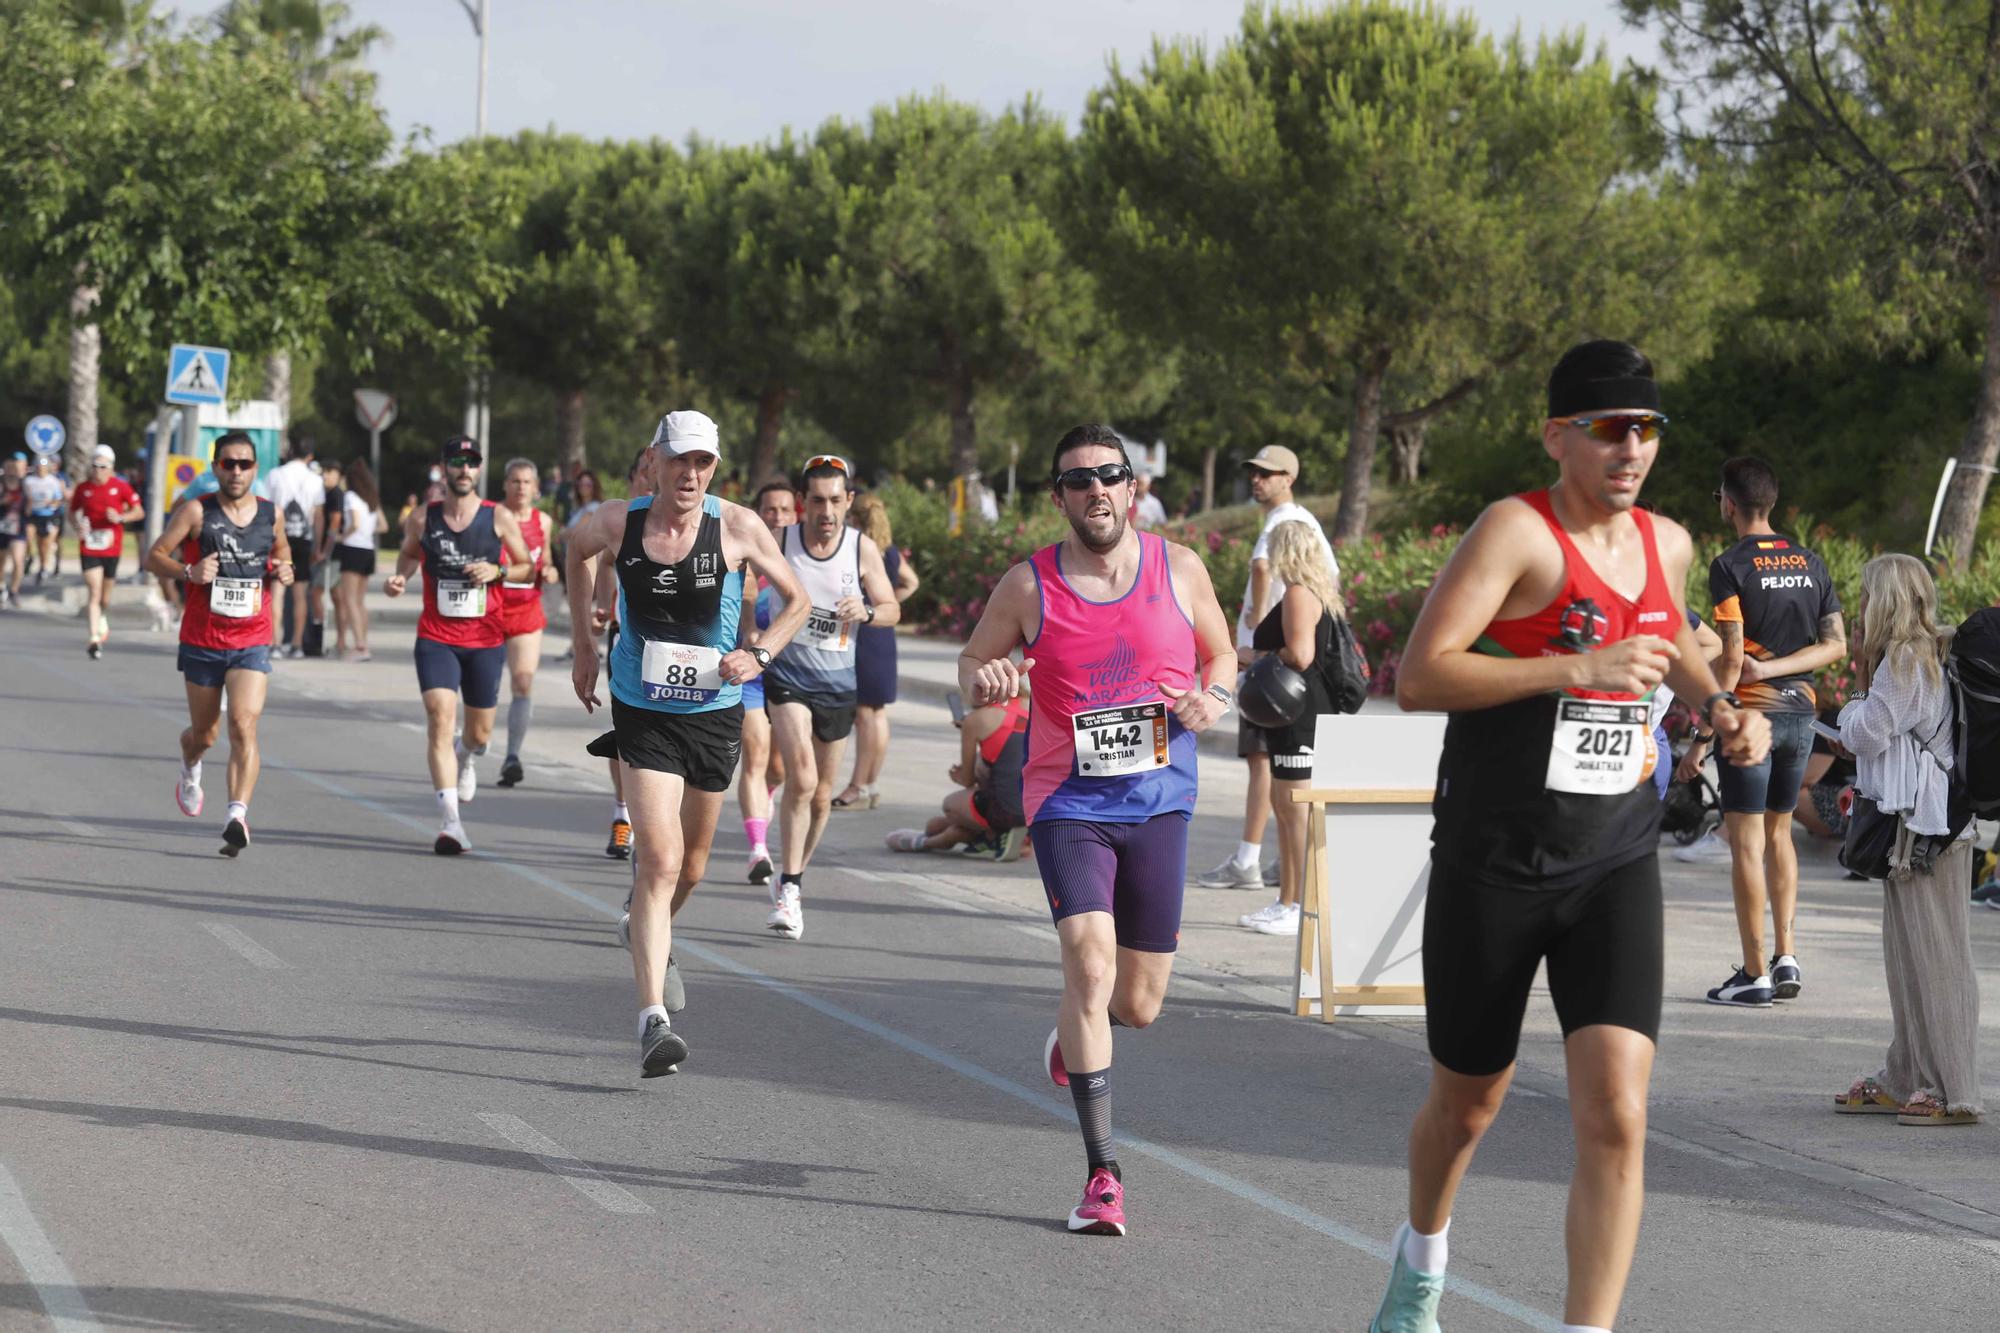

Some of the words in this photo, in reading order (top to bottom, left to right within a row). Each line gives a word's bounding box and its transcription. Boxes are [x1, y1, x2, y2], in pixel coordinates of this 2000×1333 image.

[1752, 555, 1807, 567] RAJAOS
[1761, 575, 1813, 590] PEJOTA
[223, 590, 245, 601] 1918
[448, 591, 468, 602] 1917
[808, 617, 836, 634] 2100
[666, 664, 698, 687] 88
[1089, 665, 1140, 688] velas
[650, 686, 704, 701] Joma
[1091, 725, 1142, 751] 1442
[1156, 725, 1164, 738] BOX
[1576, 728, 1633, 756] 2021
[1099, 749, 1135, 761] CRISTIAN
